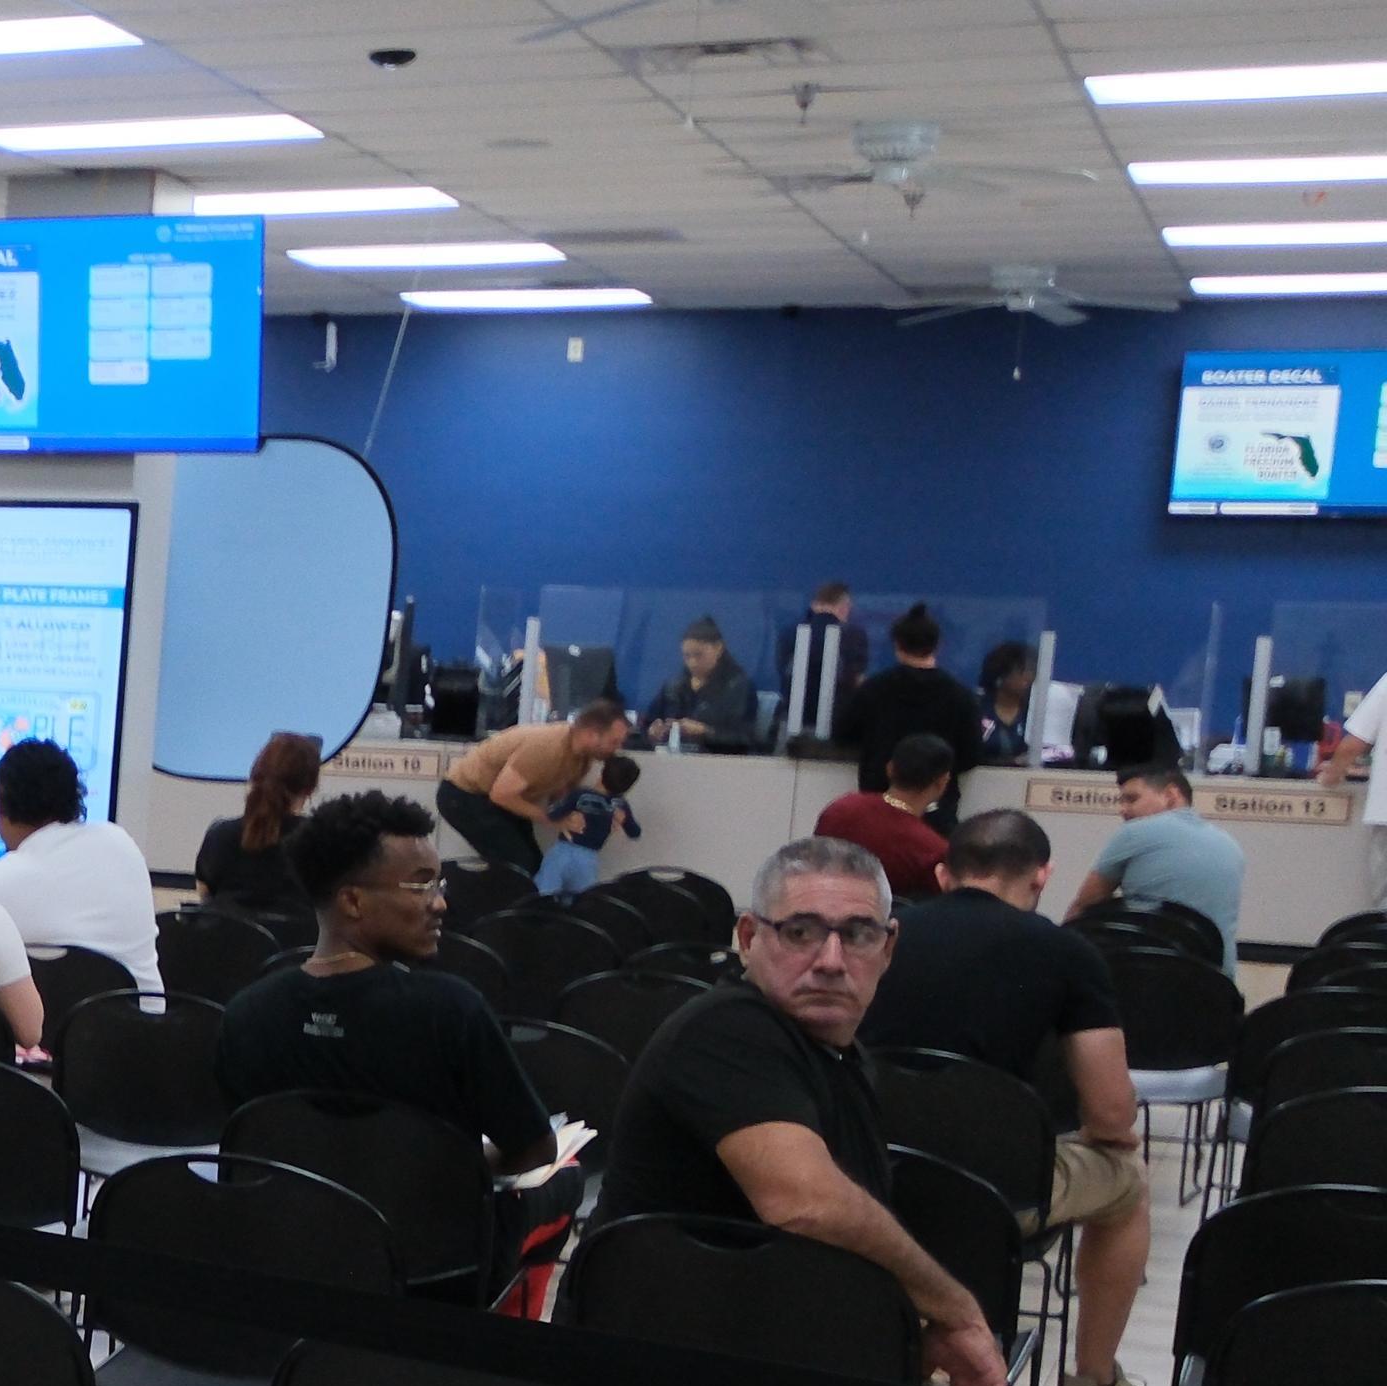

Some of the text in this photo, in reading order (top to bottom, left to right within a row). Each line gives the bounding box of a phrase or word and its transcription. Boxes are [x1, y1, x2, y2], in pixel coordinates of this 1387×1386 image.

[2, 586, 47, 602] PLATE
[49, 588, 109, 604] FRAMES
[1214, 794, 1293, 815] Station
